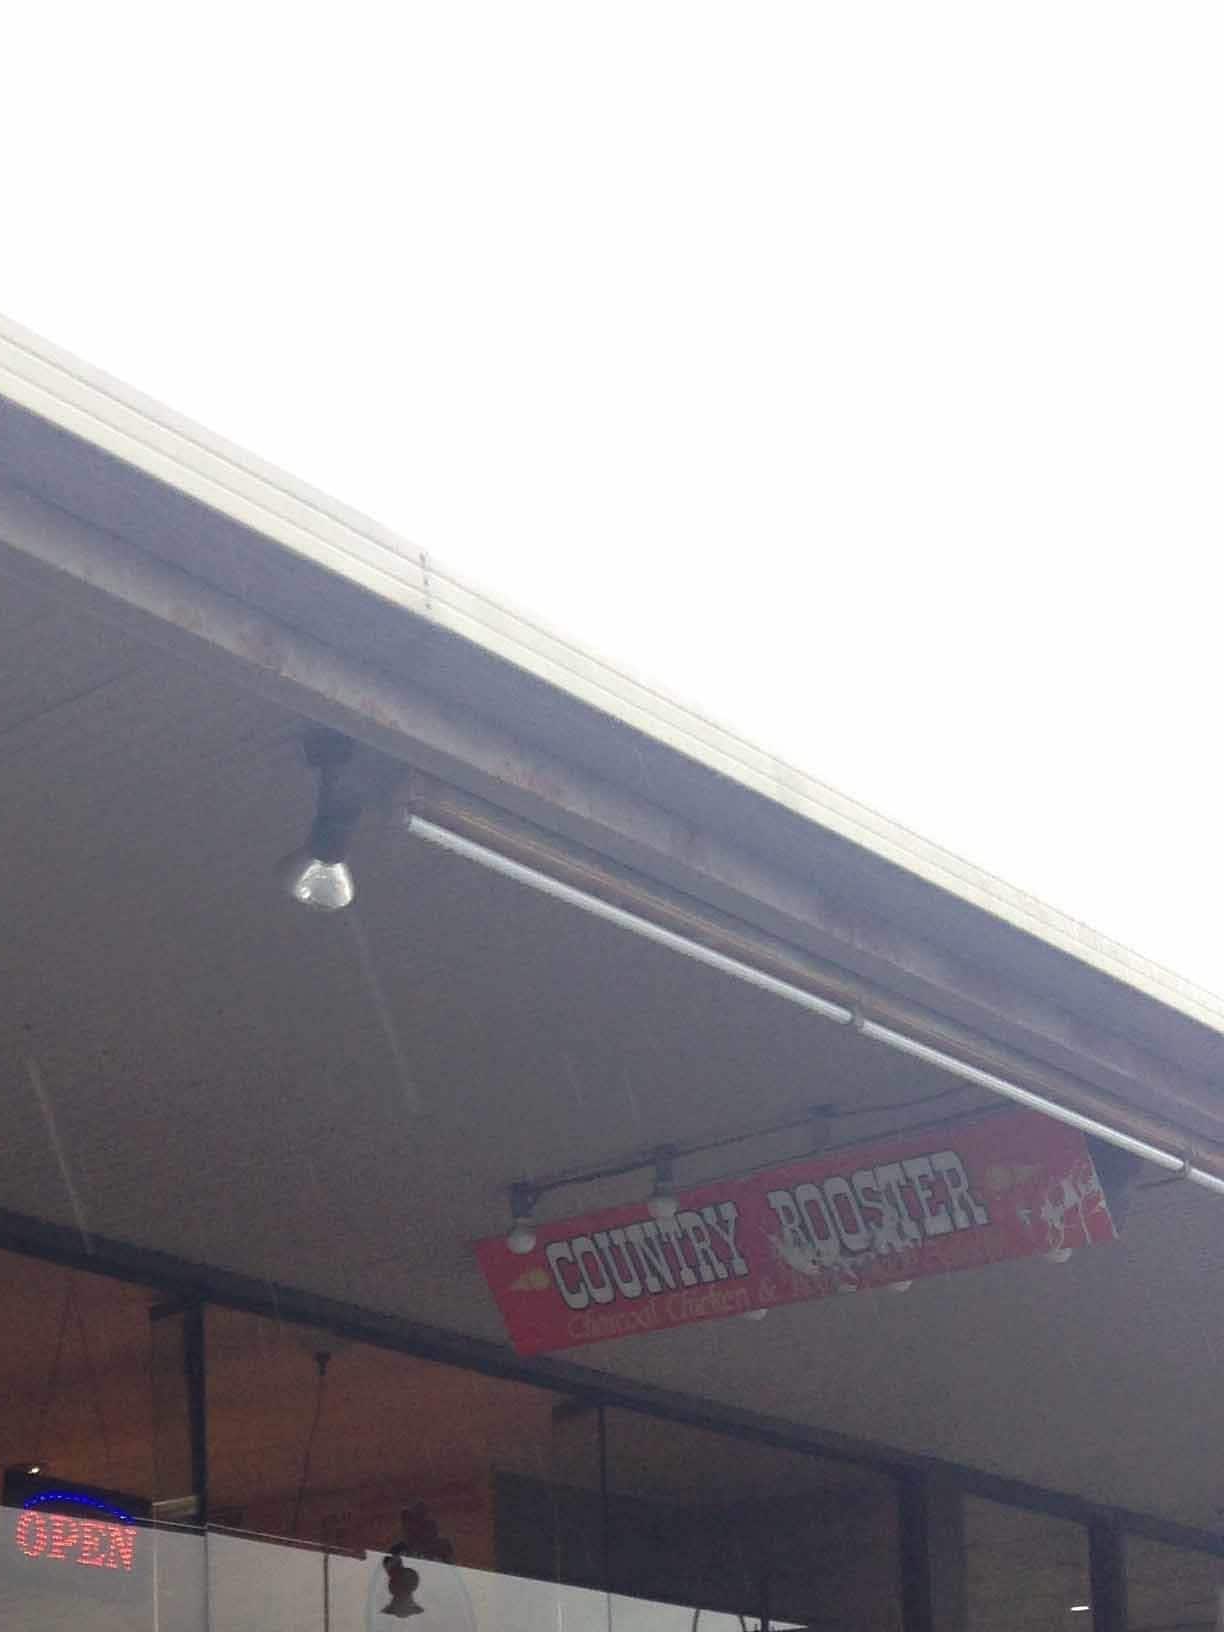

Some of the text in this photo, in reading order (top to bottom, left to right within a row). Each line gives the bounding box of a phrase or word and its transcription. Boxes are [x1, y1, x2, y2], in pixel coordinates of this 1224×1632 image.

[544, 1202, 750, 1310] COUNTRY
[767, 1150, 990, 1262] ROOSTER
[15, 1510, 137, 1573] OPEN
